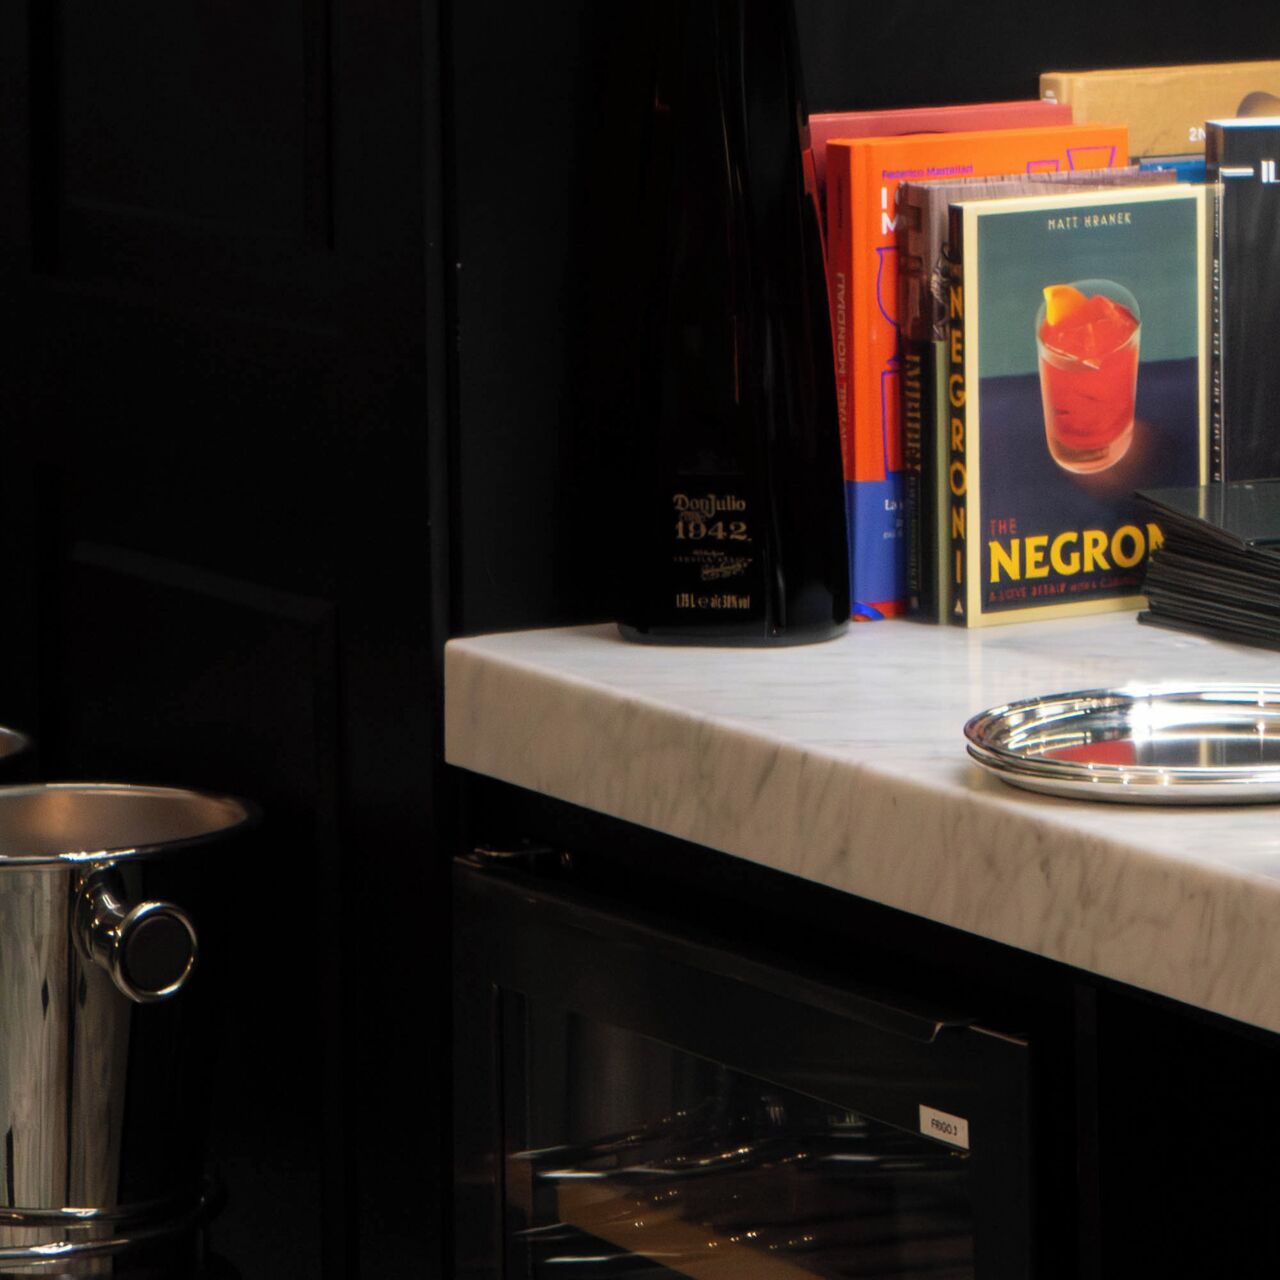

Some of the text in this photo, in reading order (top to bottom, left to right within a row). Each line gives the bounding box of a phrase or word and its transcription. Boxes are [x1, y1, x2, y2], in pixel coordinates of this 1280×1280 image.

[1047, 211, 1133, 231] MATT HRANEK
[836, 272, 847, 375] MONDIALI
[949, 285, 968, 584] NEGRONI
[675, 520, 749, 541] 1942
[989, 517, 1018, 536] THE
